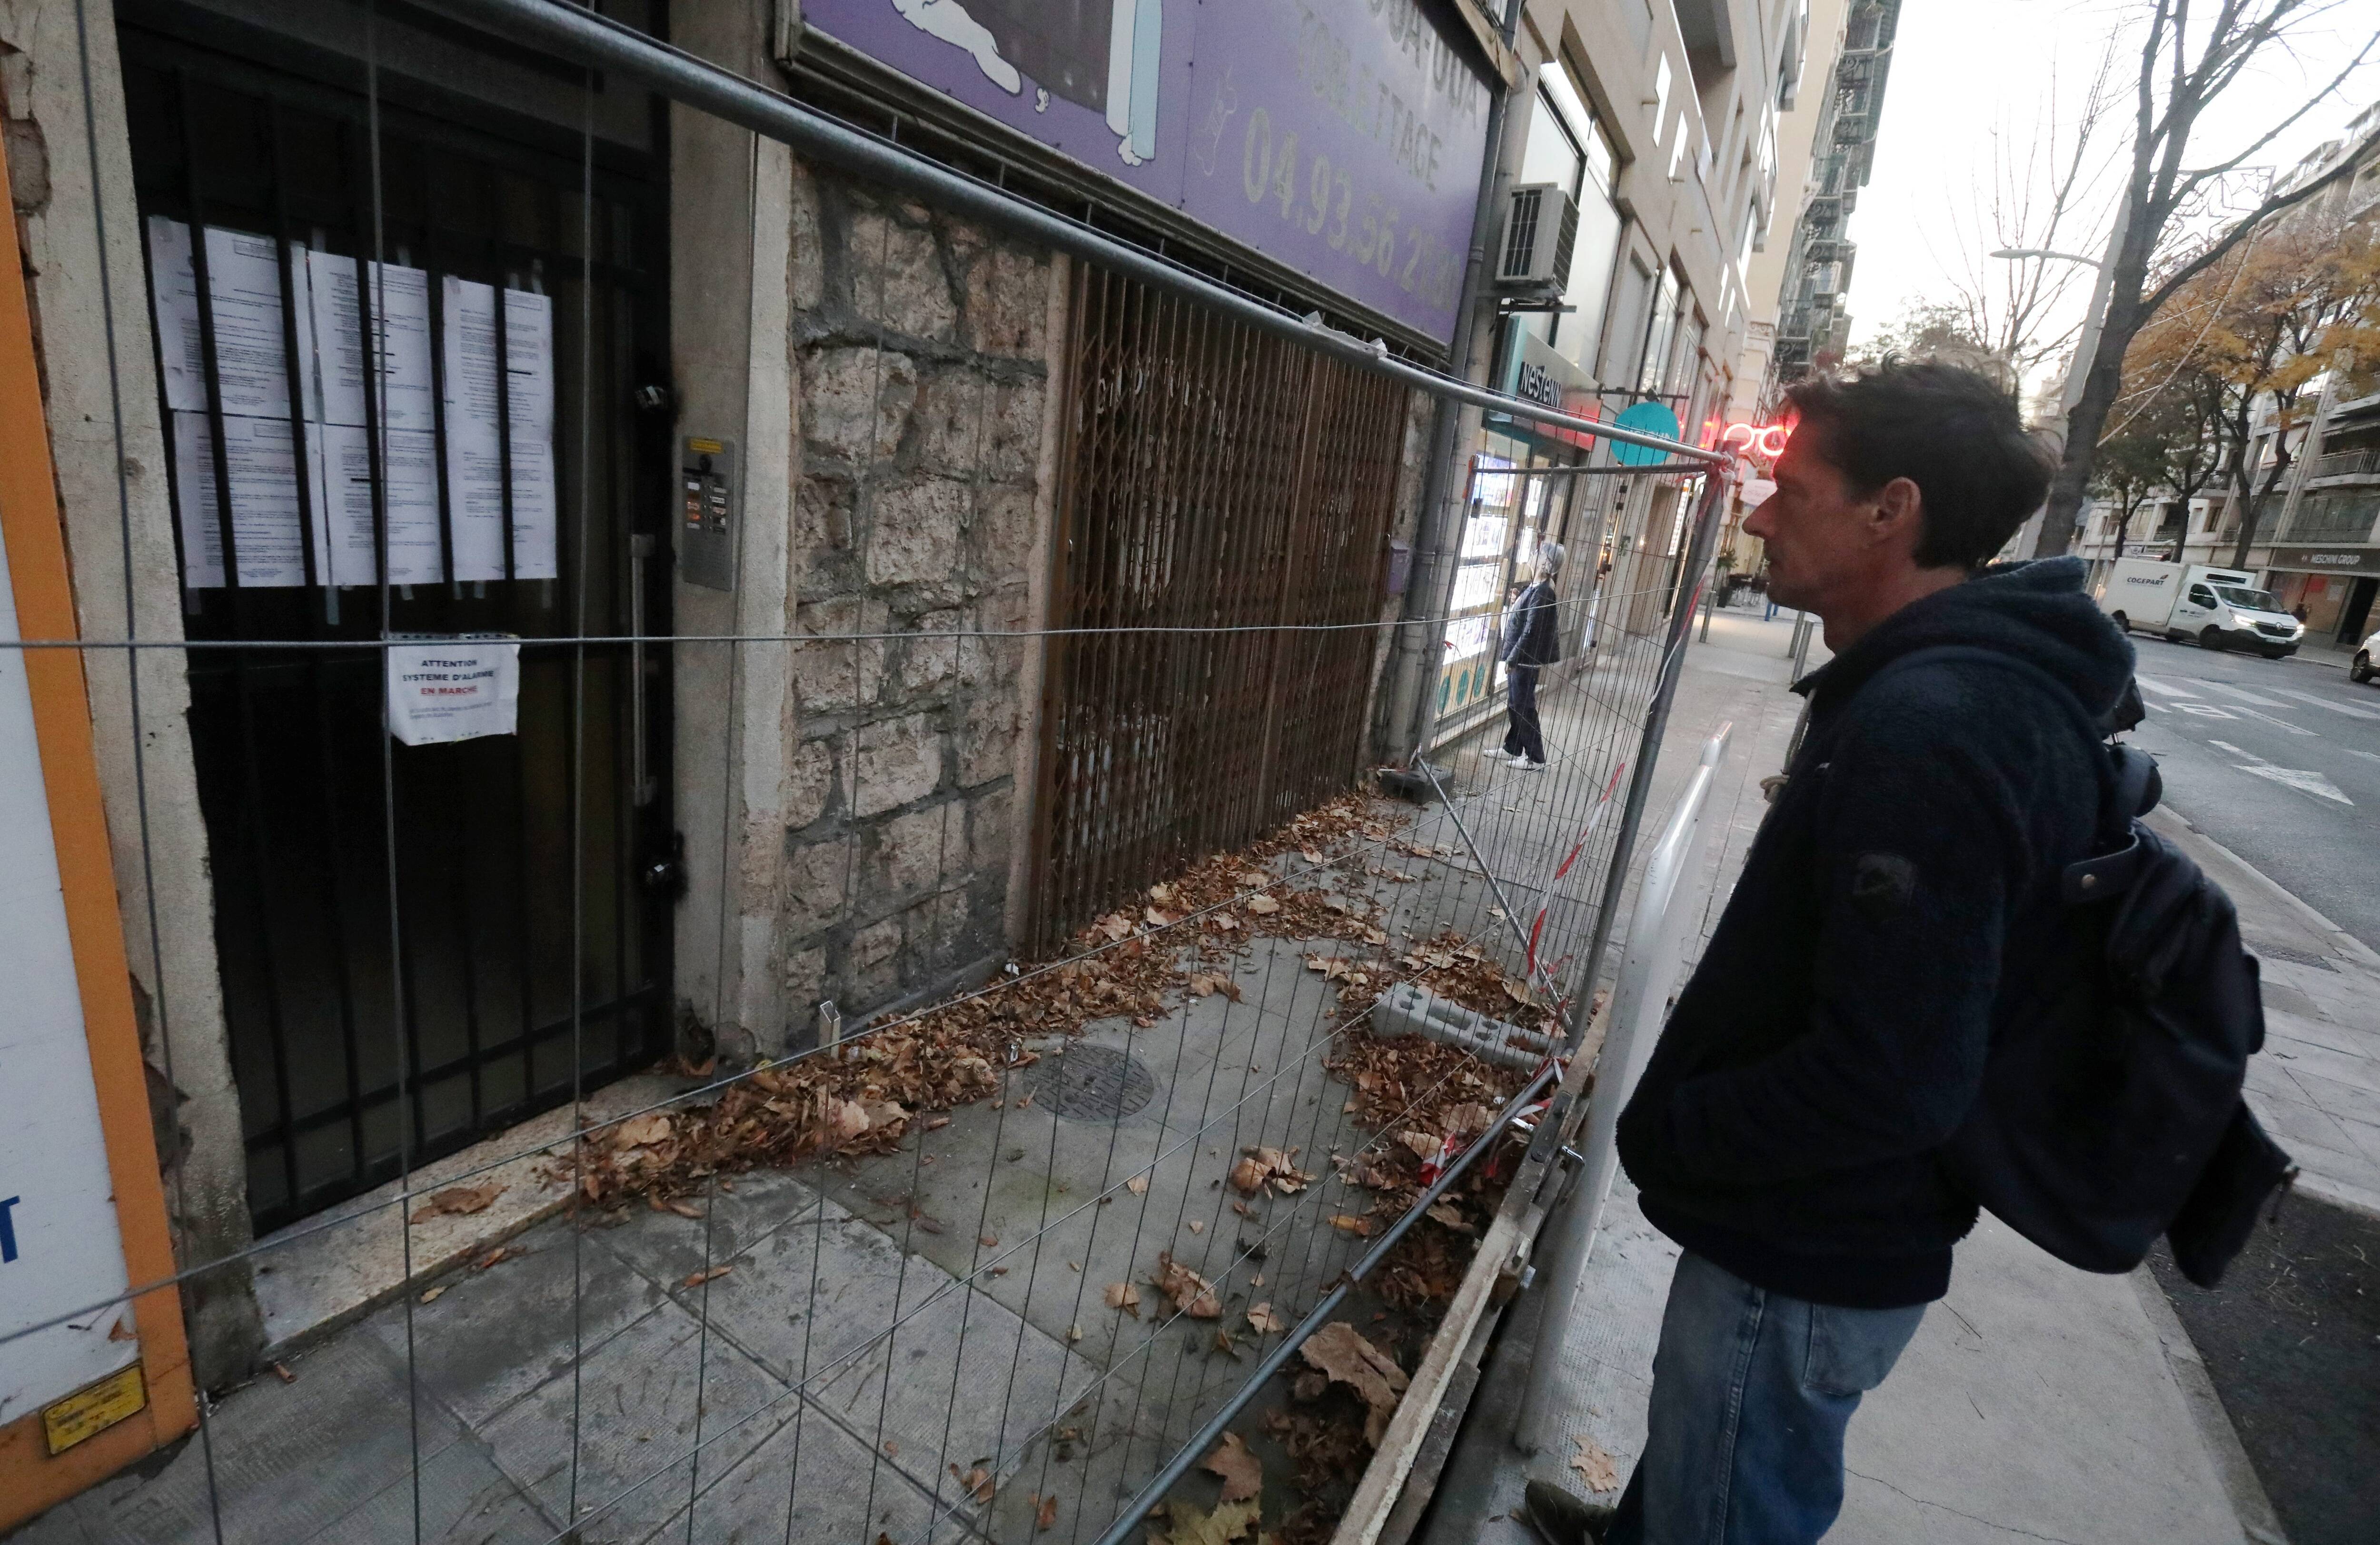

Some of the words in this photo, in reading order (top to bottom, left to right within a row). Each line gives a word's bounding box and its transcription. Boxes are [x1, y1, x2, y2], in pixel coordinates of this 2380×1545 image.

[2338, 555, 2360, 565] GROUP
[2127, 577, 2165, 585] COGEPART
[402, 673, 449, 682] SYSTEME
[453, 670, 495, 681] D'ALARME
[438, 685, 478, 694] MARCHE
